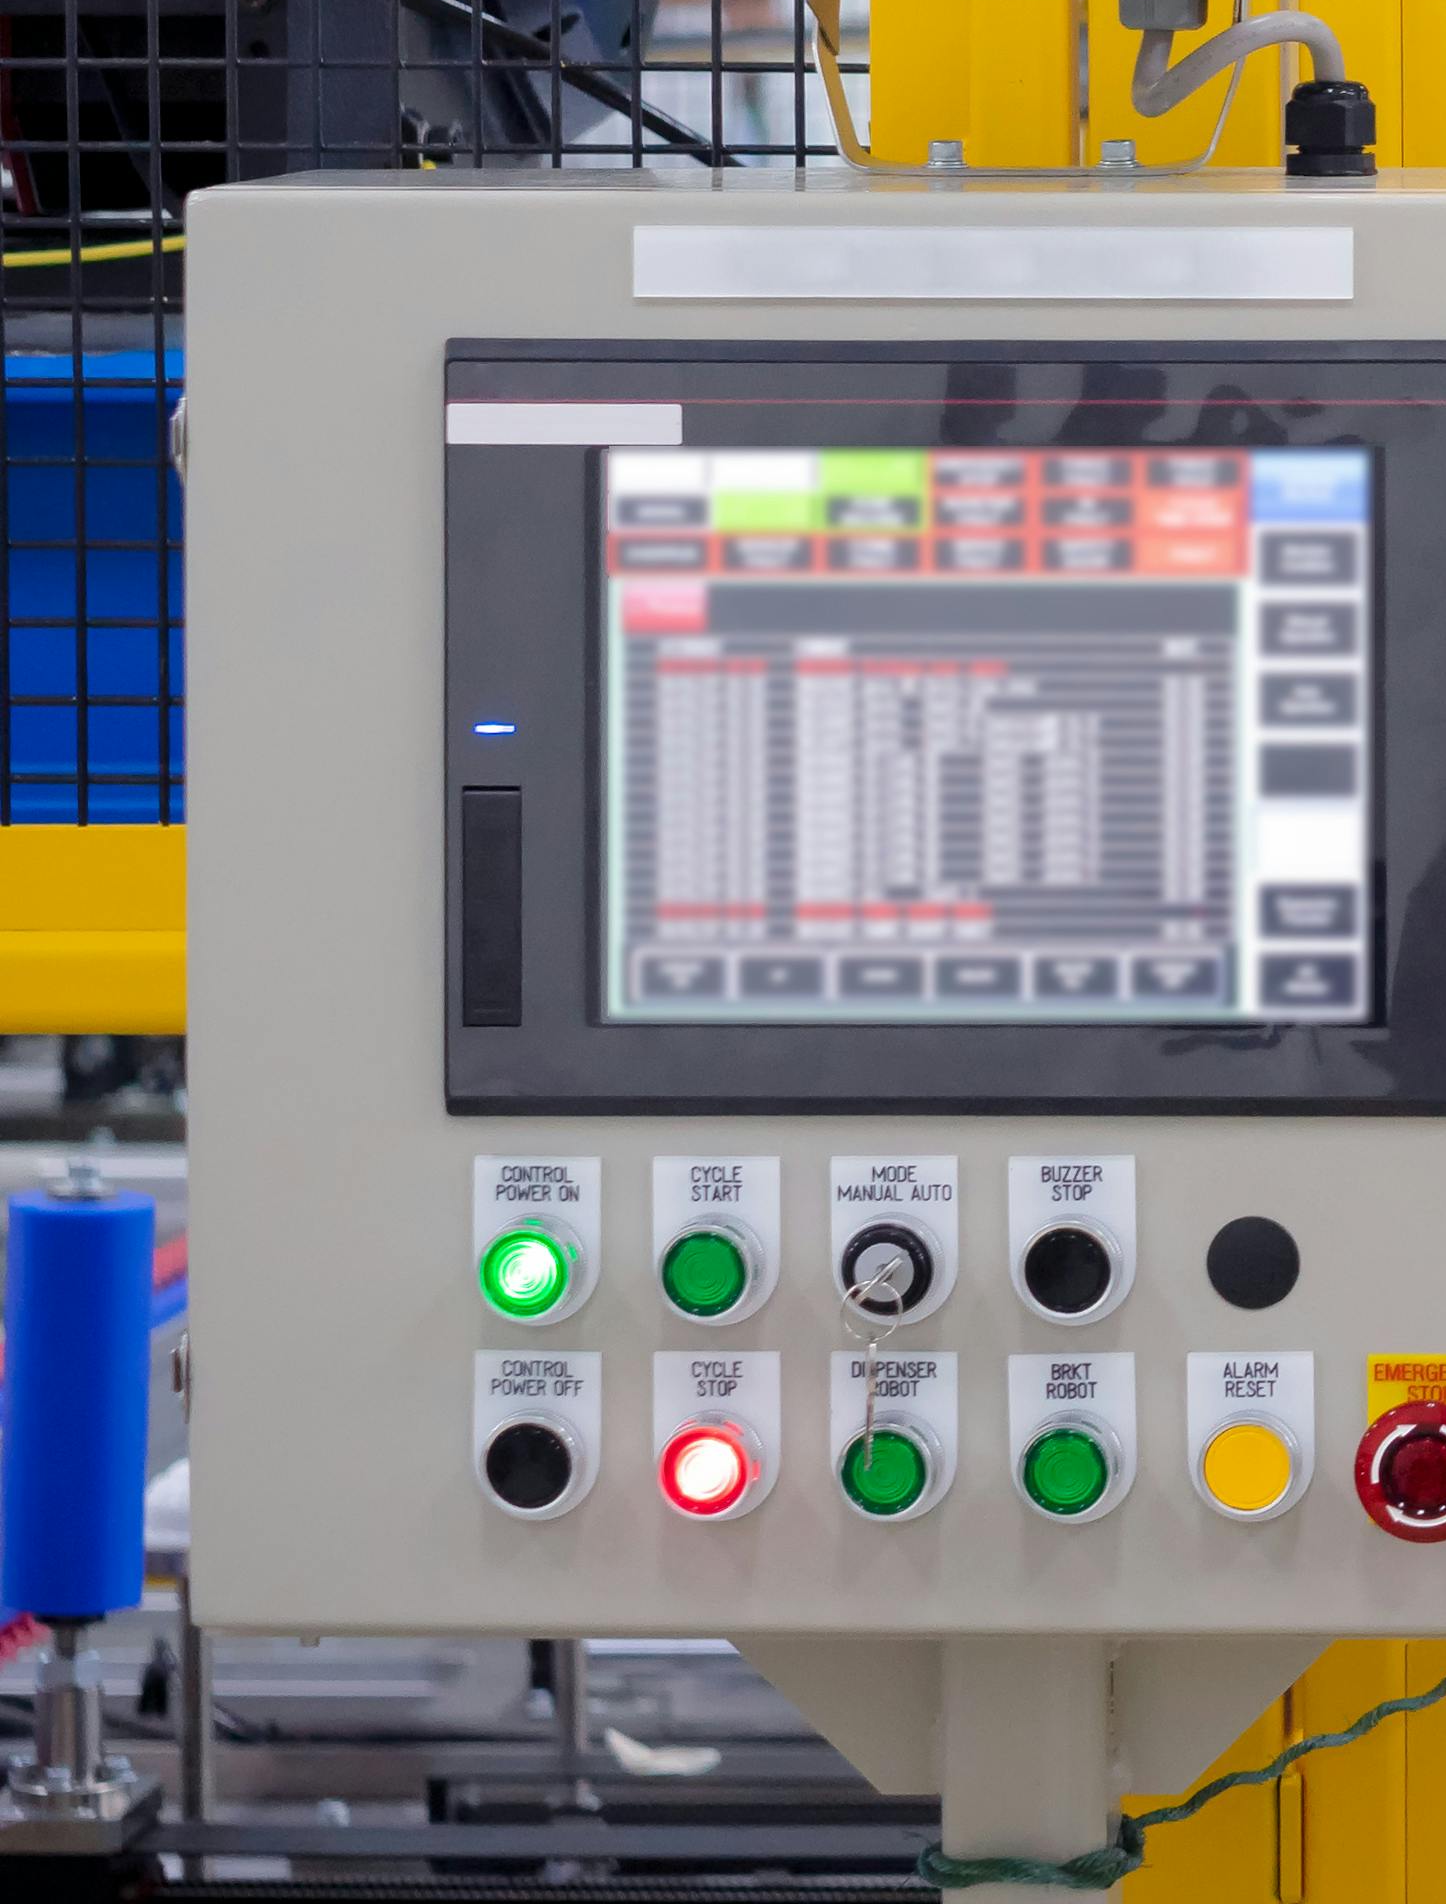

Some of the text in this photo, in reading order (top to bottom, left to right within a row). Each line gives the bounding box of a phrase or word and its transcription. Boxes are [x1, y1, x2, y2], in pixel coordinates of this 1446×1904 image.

[502, 1165, 574, 1183] CONTROL
[691, 1165, 743, 1183] CYCLE
[871, 1165, 918, 1183] MODE
[1041, 1165, 1103, 1183] BUZZER
[495, 1184, 580, 1202] POWER ON
[691, 1184, 742, 1202] START
[837, 1184, 952, 1202] MANUAL AUTO
[1052, 1184, 1093, 1202] STOP
[501, 1360, 574, 1378] CONTROL
[691, 1361, 744, 1379] CYCLE
[851, 1361, 938, 1379] DIPENSER
[1051, 1362, 1092, 1380] BRKT
[1223, 1361, 1280, 1379] ALARM
[490, 1379, 584, 1397] POWER OFF
[697, 1380, 738, 1397] STOP
[872, 1380, 920, 1397] OBOT
[1046, 1381, 1098, 1399] ROBOT
[1225, 1380, 1277, 1398] RESET
